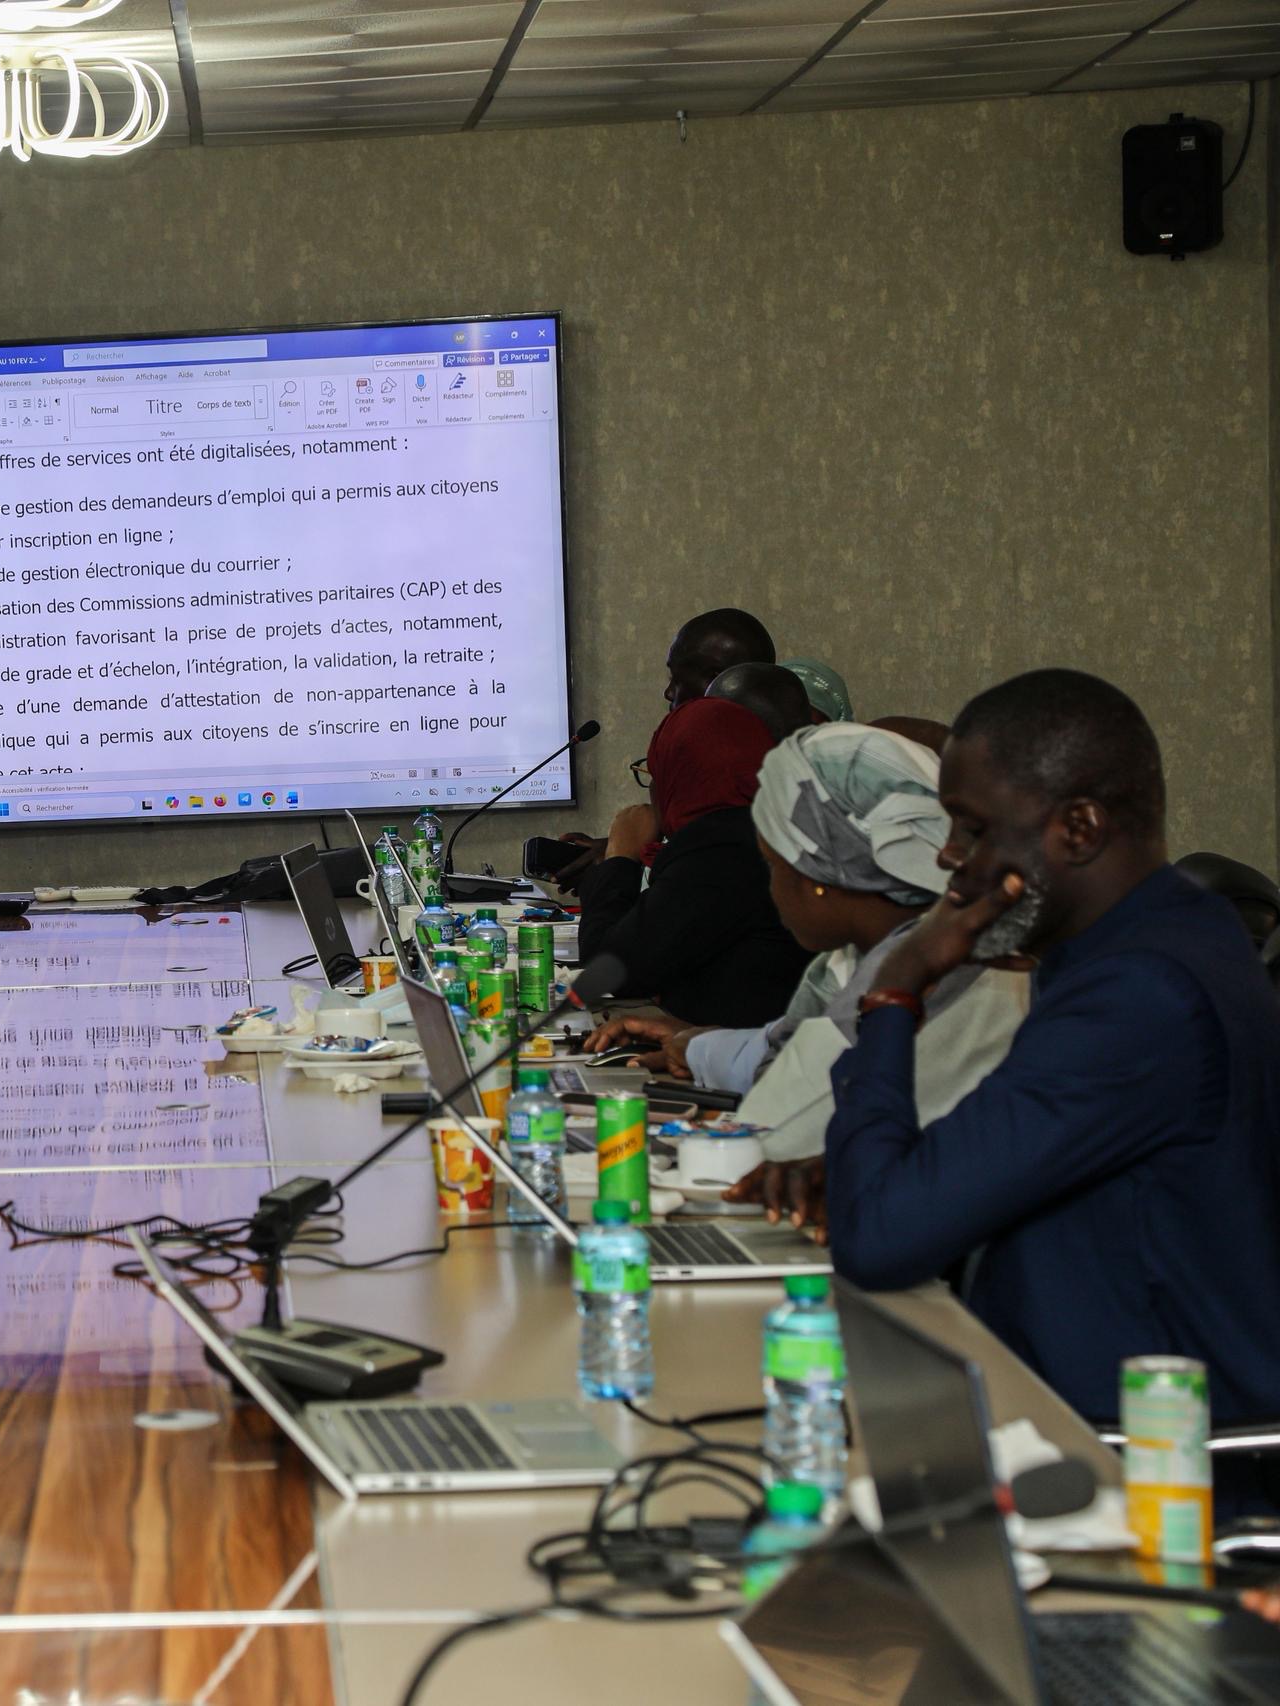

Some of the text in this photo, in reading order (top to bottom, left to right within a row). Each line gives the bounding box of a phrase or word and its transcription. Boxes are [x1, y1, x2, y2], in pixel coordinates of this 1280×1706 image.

[510, 351, 540, 362] Partager
[384, 359, 435, 368] Commentaires
[96, 374, 125, 383] Révision
[135, 372, 168, 381] Affichage
[178, 370, 194, 378] Aide
[203, 369, 231, 378] Acrobat
[42, 376, 86, 386] Publipostage
[90, 405, 119, 414] Normal
[145, 399, 183, 414] Titre
[197, 401, 220, 411] Corps
[222, 400, 232, 408] de
[40, 451, 61, 468] de
[66, 449, 132, 467] services
[136, 447, 165, 463] ont
[169, 443, 196, 462] été
[200, 439, 296, 463] digitalisées,
[302, 435, 398, 455] notamment
[14, 498, 74, 519] gestion
[78, 496, 108, 512] des
[111, 494, 213, 511] demandeurs
[216, 487, 286, 507] d'emploi
[291, 485, 316, 505] qui
[321, 488, 331, 501] a
[336, 482, 392, 504] permis
[395, 483, 426, 497] aux
[430, 479, 499, 497] citoyens
[9, 530, 92, 551] inscription
[97, 532, 118, 545] en
[123, 527, 163, 547] ligne
[21, 564, 80, 585] gestion
[85, 560, 187, 580] électronique
[190, 557, 211, 574] du
[216, 555, 281, 574] courrier
[46, 597, 75, 614] des
[79, 593, 186, 611] Commissions
[190, 587, 314, 608] administratives
[318, 584, 395, 606] paritaires
[399, 580, 447, 601] (CAP)
[451, 580, 469, 596] et
[473, 578, 503, 596] des
[74, 627, 156, 646] favorisant
[164, 626, 179, 643] la
[188, 624, 227, 645] prise
[235, 623, 257, 639] de
[265, 620, 322, 641] projets
[330, 618, 393, 636] d'actes,
[403, 612, 503, 632] notamment,
[0, 666, 21, 684] de
[25, 664, 75, 685] grade
[77, 663, 95, 680] et
[98, 660, 181, 679] d'échelon,
[186, 655, 288, 676] l'intégration,
[294, 653, 308, 670] la
[313, 650, 398, 669] validation,
[403, 648, 418, 665] la
[423, 646, 484, 664] retraite
[16, 698, 61, 715] d'une
[72, 694, 150, 713] demande
[160, 688, 261, 709] d'attestation
[273, 687, 294, 704] de
[306, 684, 457, 704] non-appartenance
[468, 678, 479, 696] à
[491, 678, 506, 696] la
[45, 730, 70, 750] qui
[79, 733, 90, 745] a
[99, 727, 154, 748] permis
[163, 728, 193, 742] aux
[201, 723, 269, 743] citoyens
[278, 720, 299, 737] de
[308, 718, 380, 736] s'inscrire
[389, 719, 410, 733] en
[420, 715, 460, 734] ligne
[469, 715, 508, 733] pour
[36, 803, 74, 812] Rechercher
